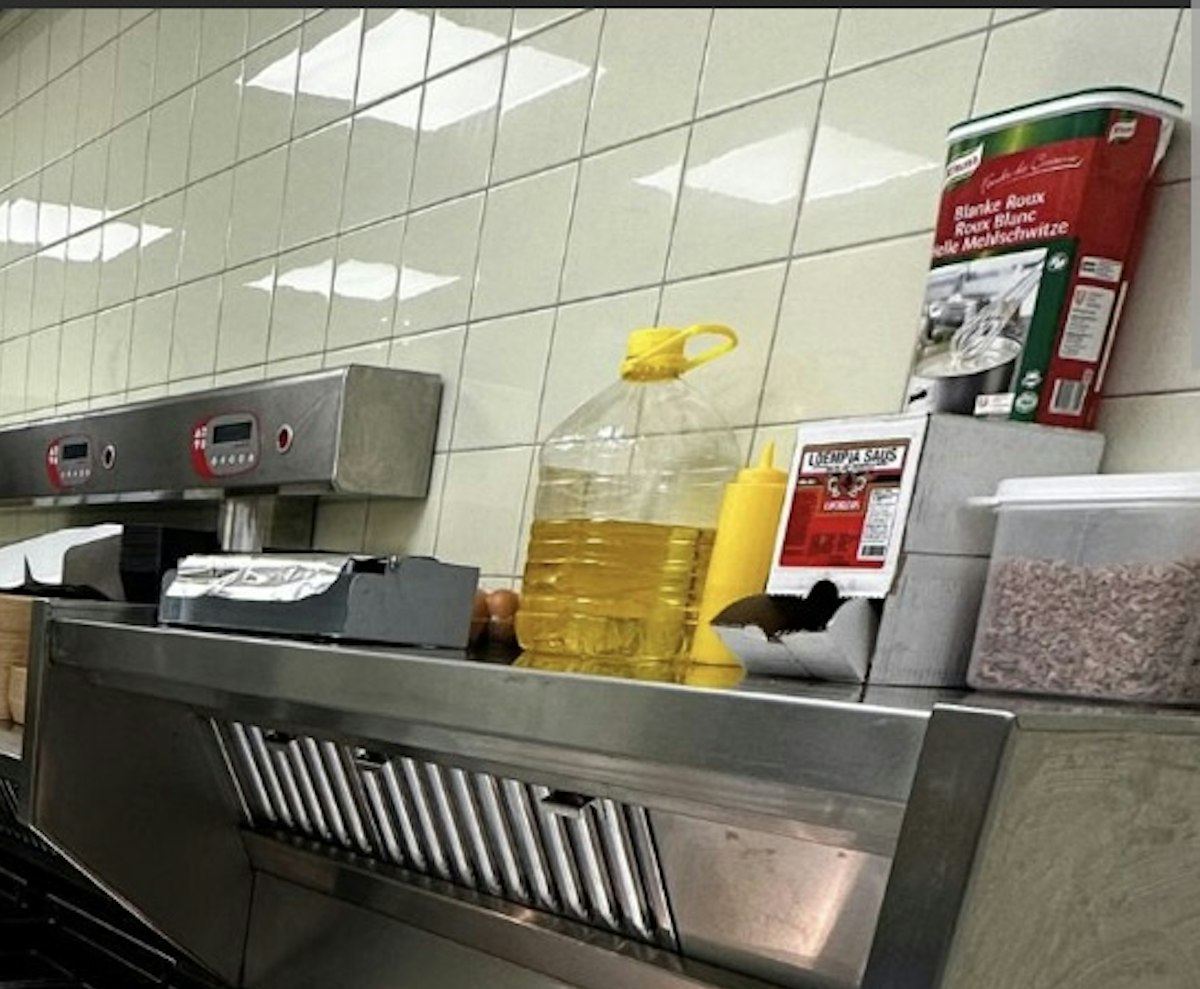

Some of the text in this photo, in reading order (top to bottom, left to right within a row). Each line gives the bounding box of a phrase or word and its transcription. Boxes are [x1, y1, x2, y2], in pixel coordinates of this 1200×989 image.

[955, 192, 1046, 220] Blanke Roux
[955, 210, 1037, 236] Roux Blanc
[962, 221, 1070, 251] Mehlschwitze
